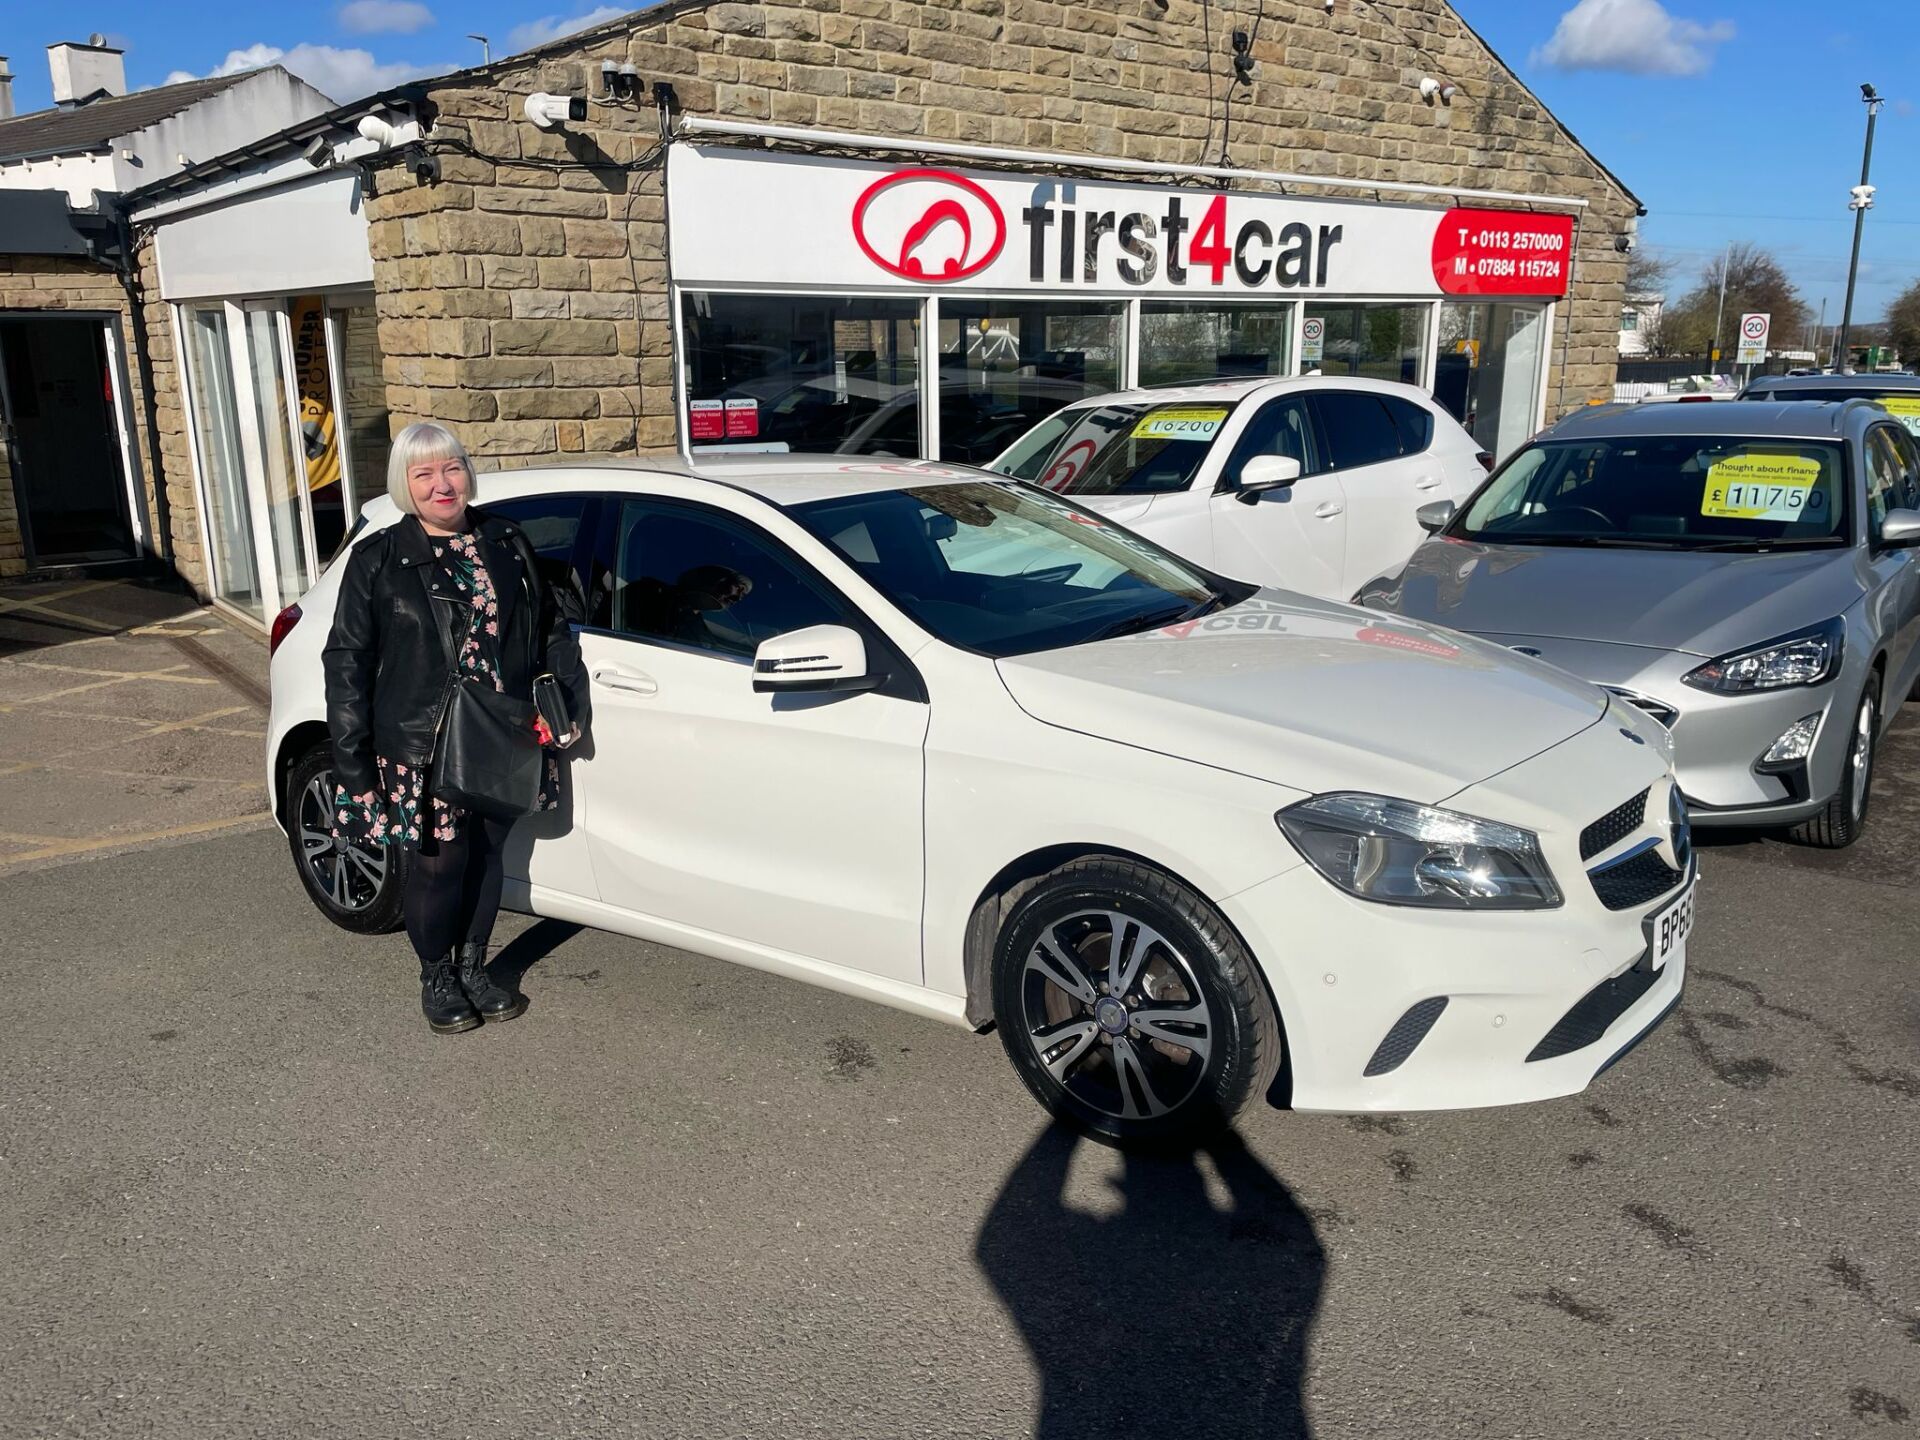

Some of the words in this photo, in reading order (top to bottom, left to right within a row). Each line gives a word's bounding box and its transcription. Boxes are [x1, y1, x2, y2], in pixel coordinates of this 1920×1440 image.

[1023, 180, 1343, 288] first4car
[1458, 229, 1468, 247] T
[1480, 230, 1509, 248] 0113
[1512, 232, 1563, 251] 2570000
[1454, 257, 1467, 275] M
[1478, 258, 1515, 276] 07884
[1519, 259, 1559, 277] 115724
[1306, 324, 1320, 334] 20
[1747, 322, 1763, 332] 20
[1154, 421, 1215, 433] 16200
[1717, 462, 1754, 473] Thought
[1757, 464, 1784, 474] about
[1711, 489, 1722, 501] £
